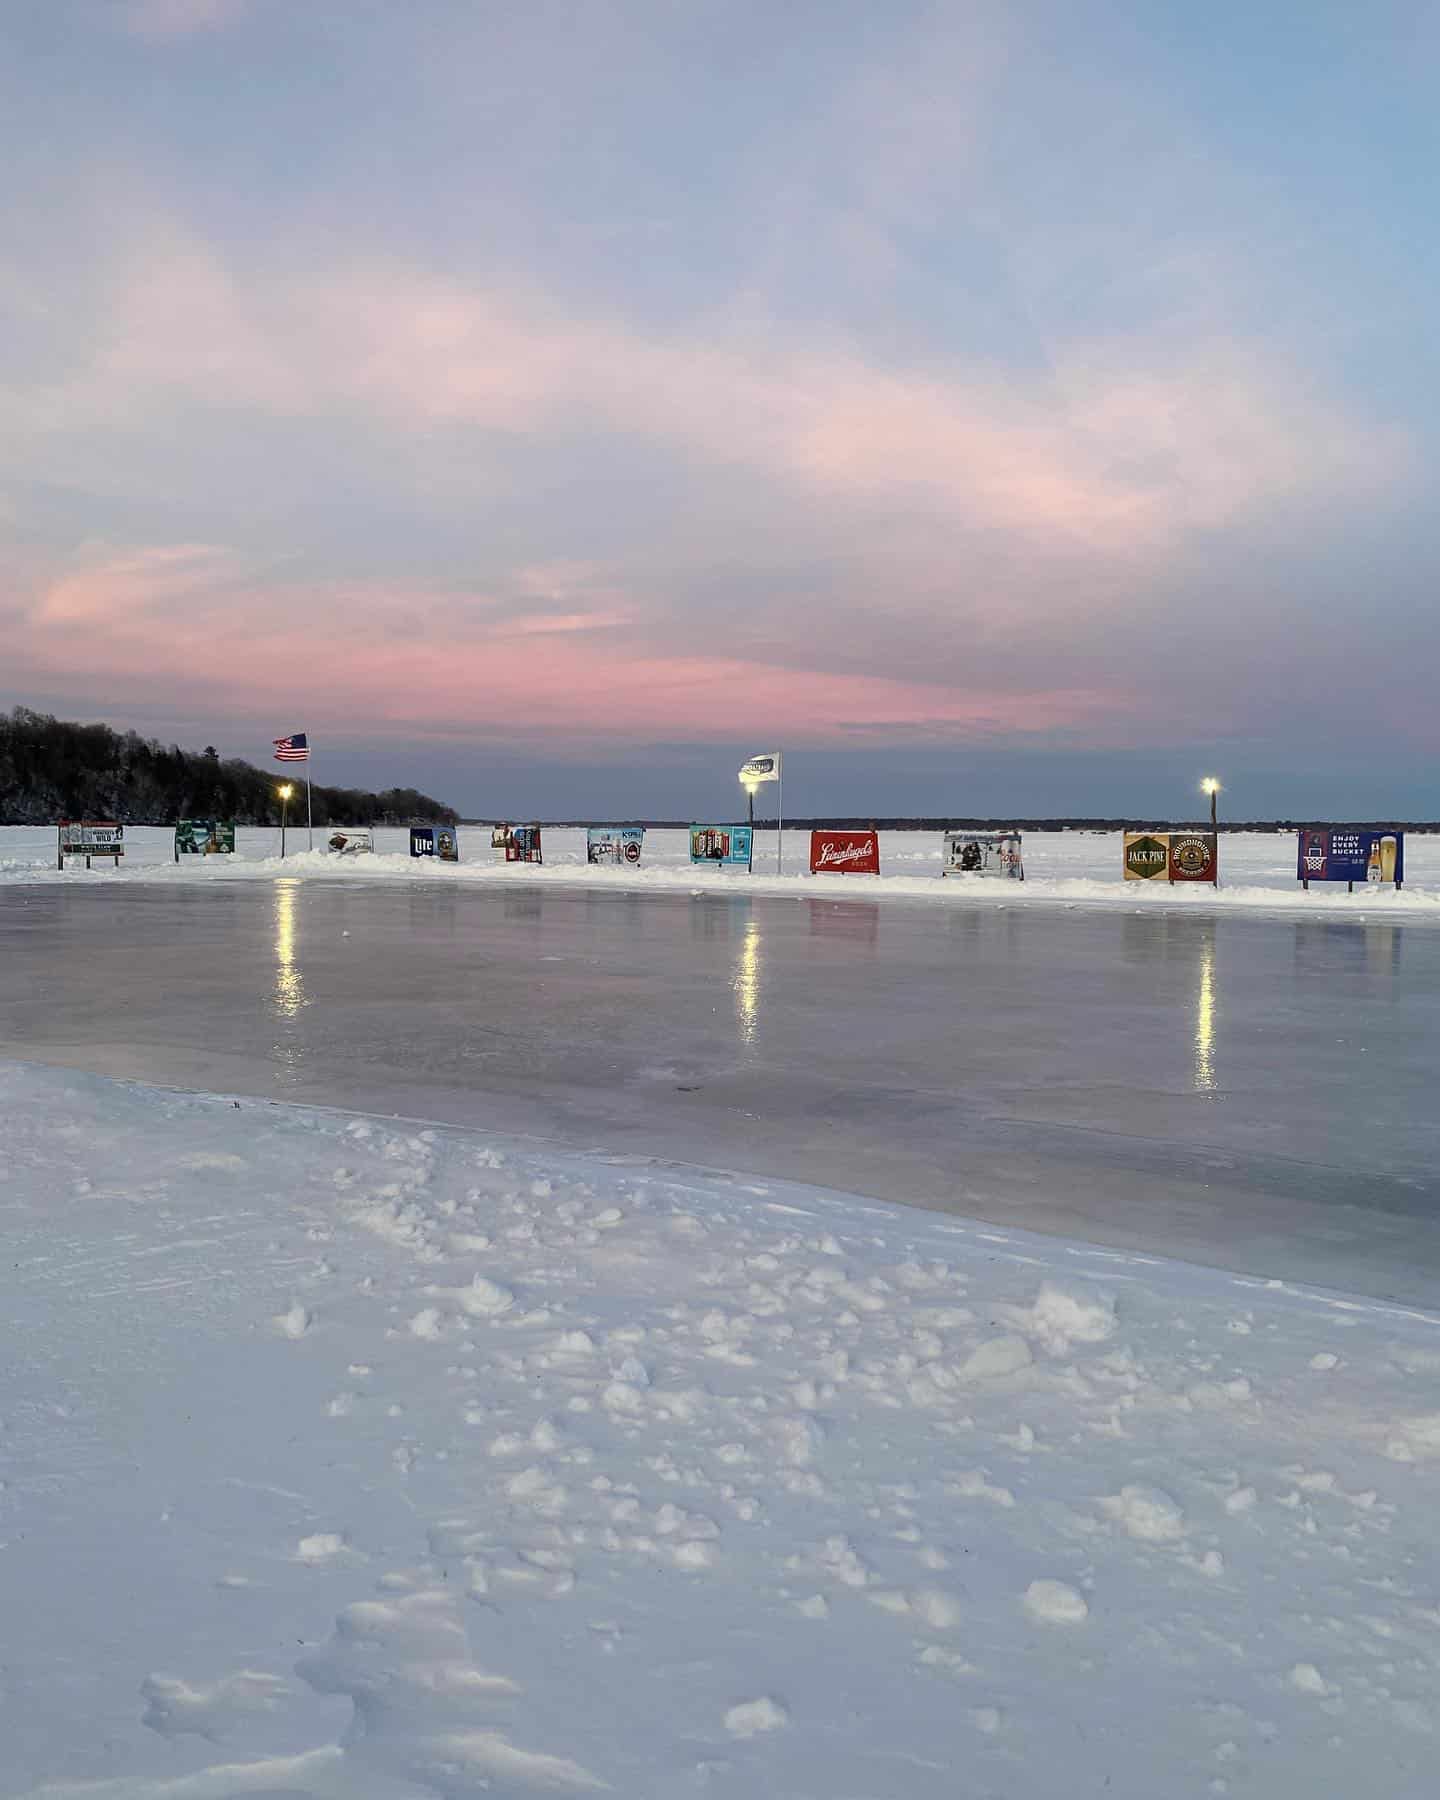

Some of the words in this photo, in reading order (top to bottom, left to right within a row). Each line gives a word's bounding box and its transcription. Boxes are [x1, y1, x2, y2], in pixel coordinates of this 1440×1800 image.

[1128, 850, 1148, 862] JACK
[1149, 850, 1165, 862] PINE
[1173, 839, 1210, 860] ROUNDHOUSE
